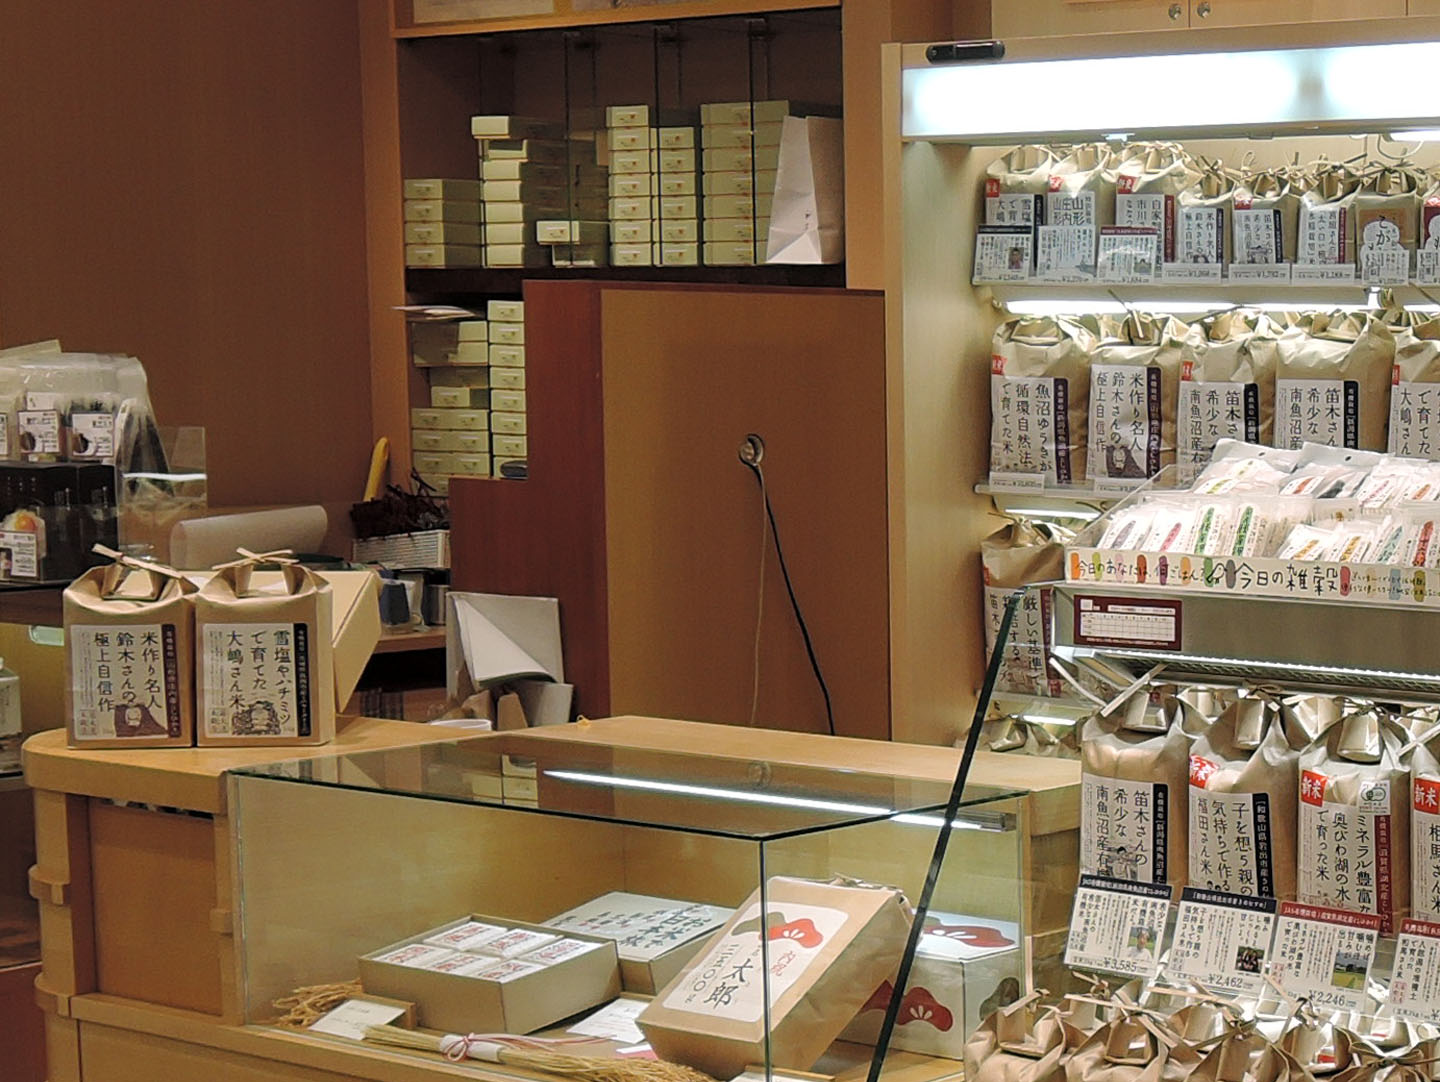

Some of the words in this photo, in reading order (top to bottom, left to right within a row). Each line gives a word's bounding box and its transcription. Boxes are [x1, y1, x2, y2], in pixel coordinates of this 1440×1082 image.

[1016, 384, 1032, 467] 循環自然法
[1095, 371, 1107, 452] 極上自信作
[1109, 371, 1125, 445] 鈴木さんの
[1130, 373, 1145, 451] 米作り名人
[1206, 390, 1220, 435] 希少な
[1290, 387, 1303, 450] 南魚沼産
[1307, 388, 1321, 435] 希少な
[1417, 390, 1431, 455] て育てた
[1235, 562, 1338, 597] 今日の雑穀
[95, 633, 115, 712] 極上自信作
[116, 632, 136, 703] 鈴木さんの
[141, 632, 162, 709] 米作り名人
[227, 631, 246, 709] 大嶋さん米
[251, 631, 267, 690] て育てた
[273, 631, 292, 724] 雪塩やハチミツ
[1114, 788, 1128, 837] 希少な
[1301, 776, 1323, 800] 新米
[1414, 784, 1438, 808] 新米
[1133, 790, 1150, 867] 笛木さんの
[1197, 798, 1212, 875] 福田さん米
[1232, 802, 1254, 896] 子を想う親の
[1333, 812, 1351, 902] 奥びわ湖の水
[1208, 973, 1243, 988] ¥2,462
[1309, 989, 1345, 1006] ¥2,246
